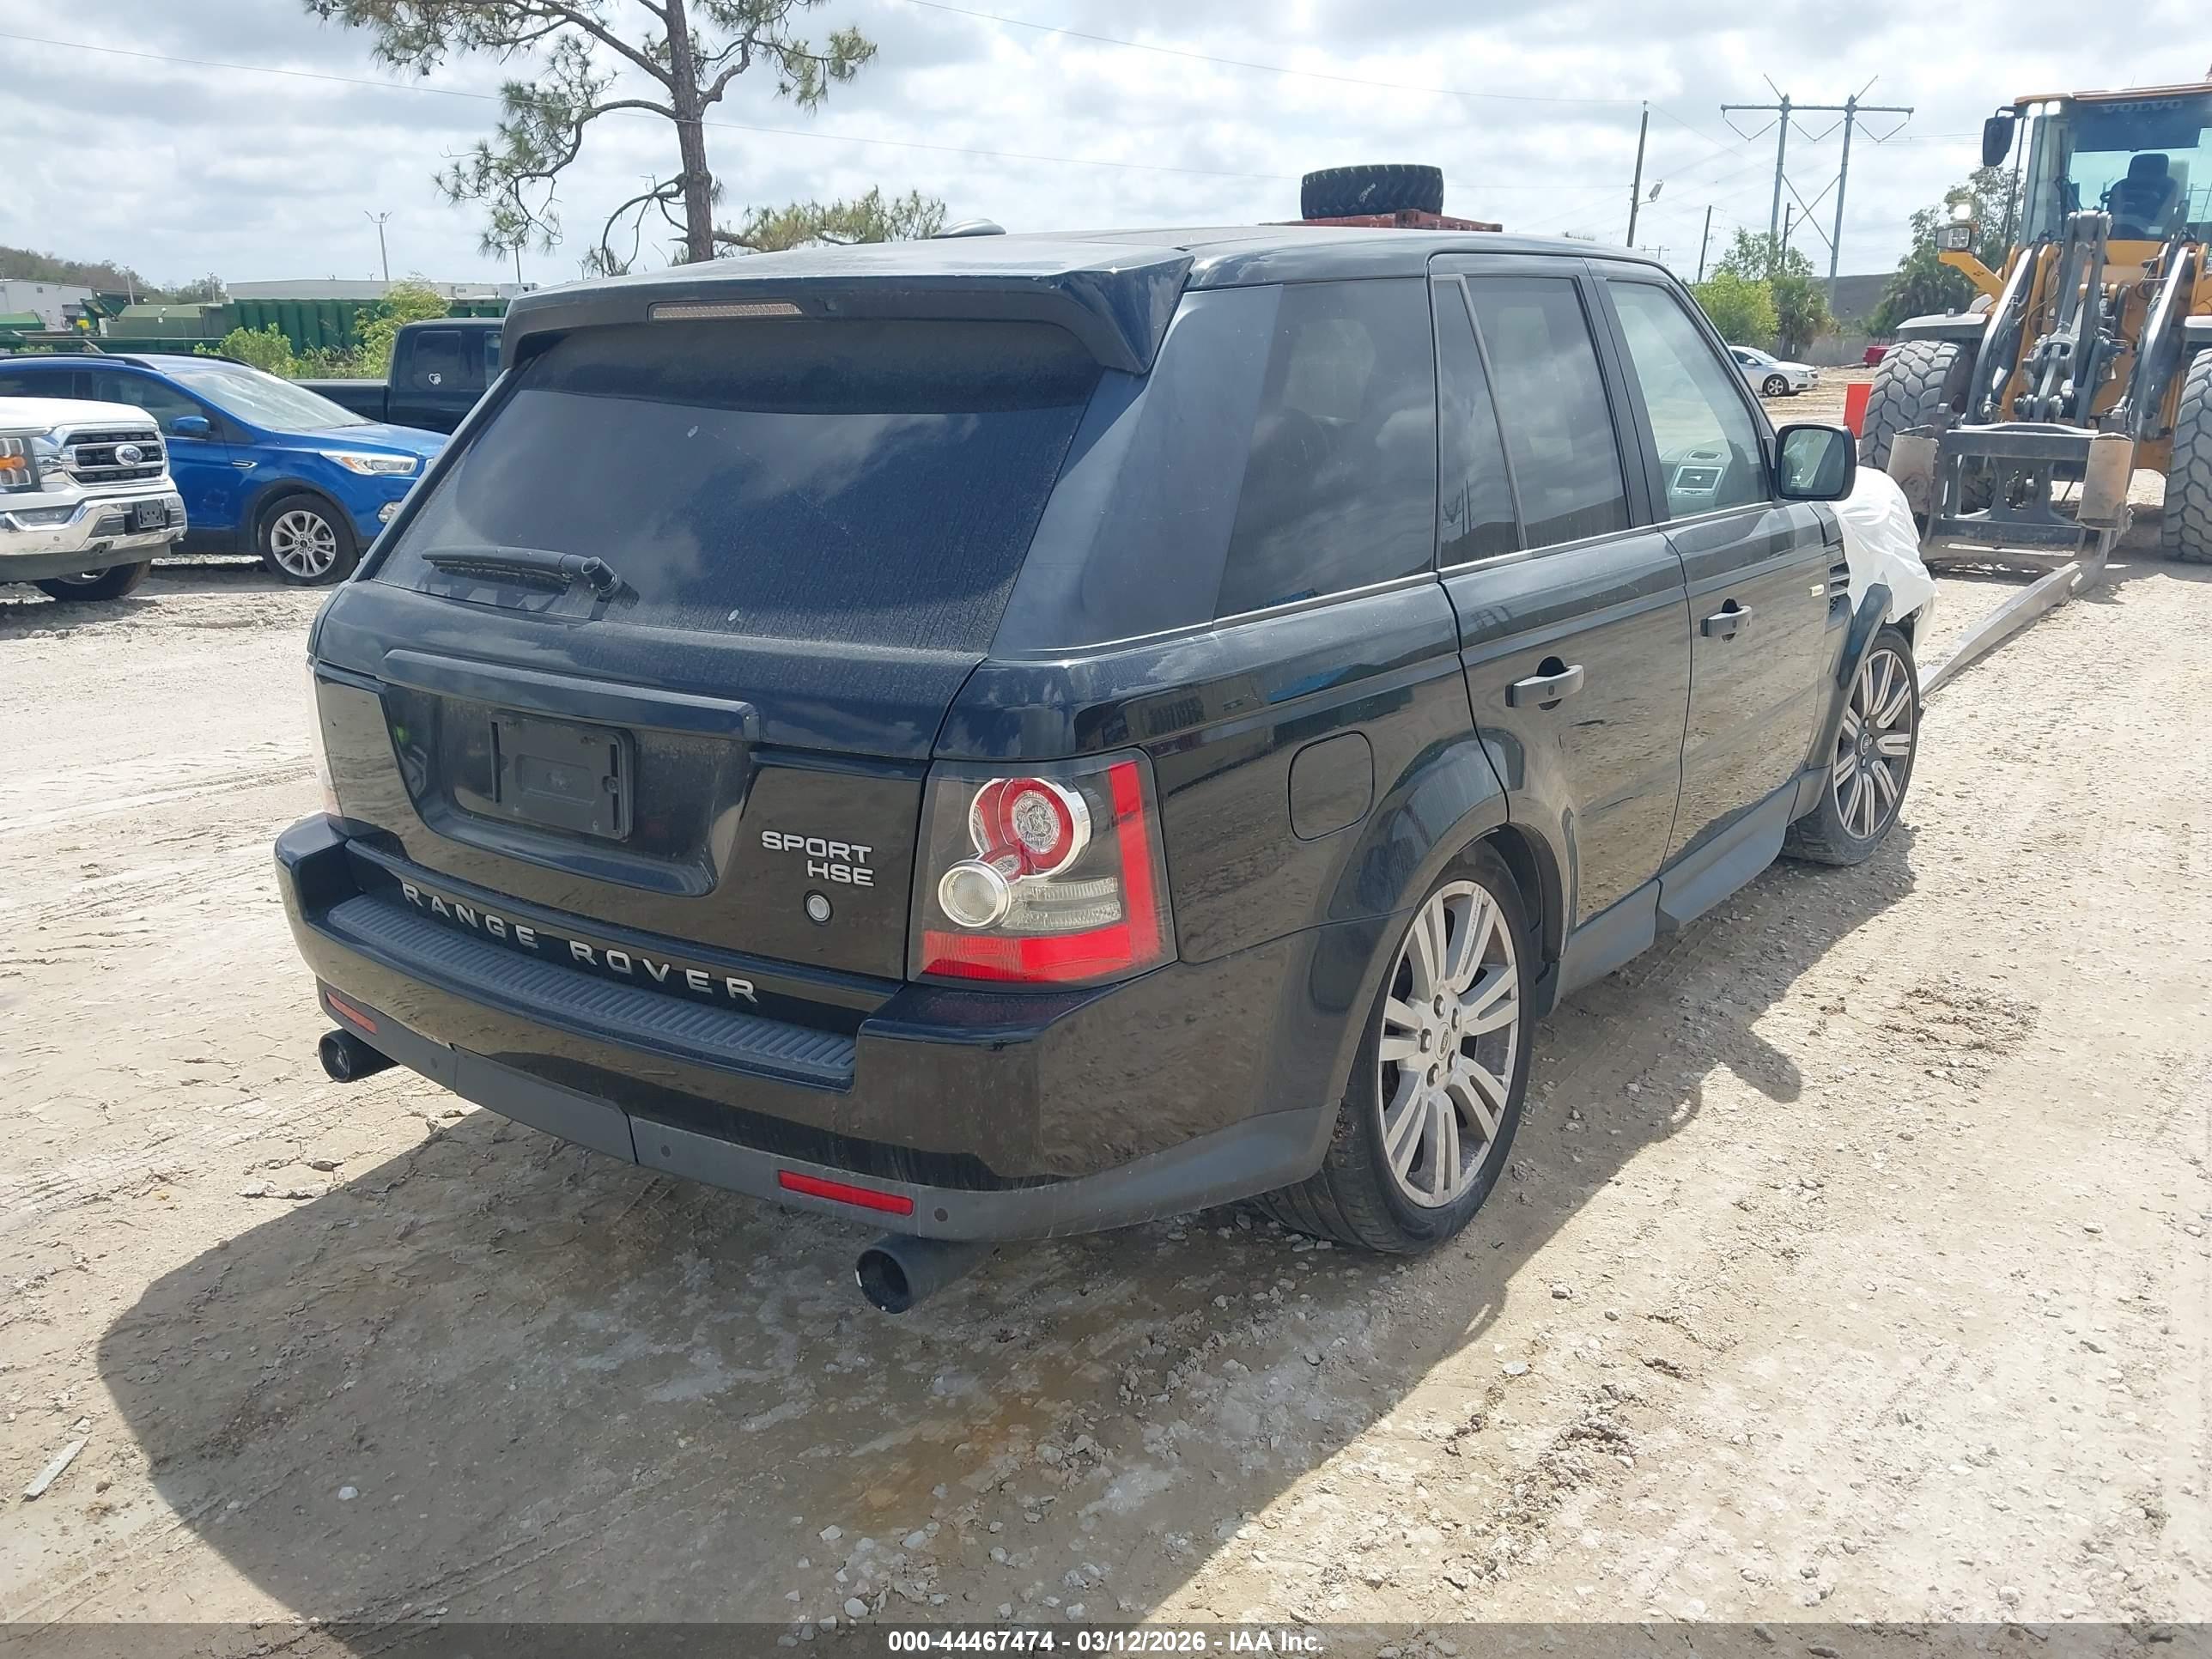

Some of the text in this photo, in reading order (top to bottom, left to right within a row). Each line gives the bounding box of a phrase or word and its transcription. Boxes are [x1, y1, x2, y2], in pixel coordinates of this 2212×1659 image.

[2101, 100, 2183, 113] VOLVO
[761, 830, 872, 864] SPORT
[807, 860, 874, 887] HSE
[402, 882, 758, 1003] RANGE ROVER
